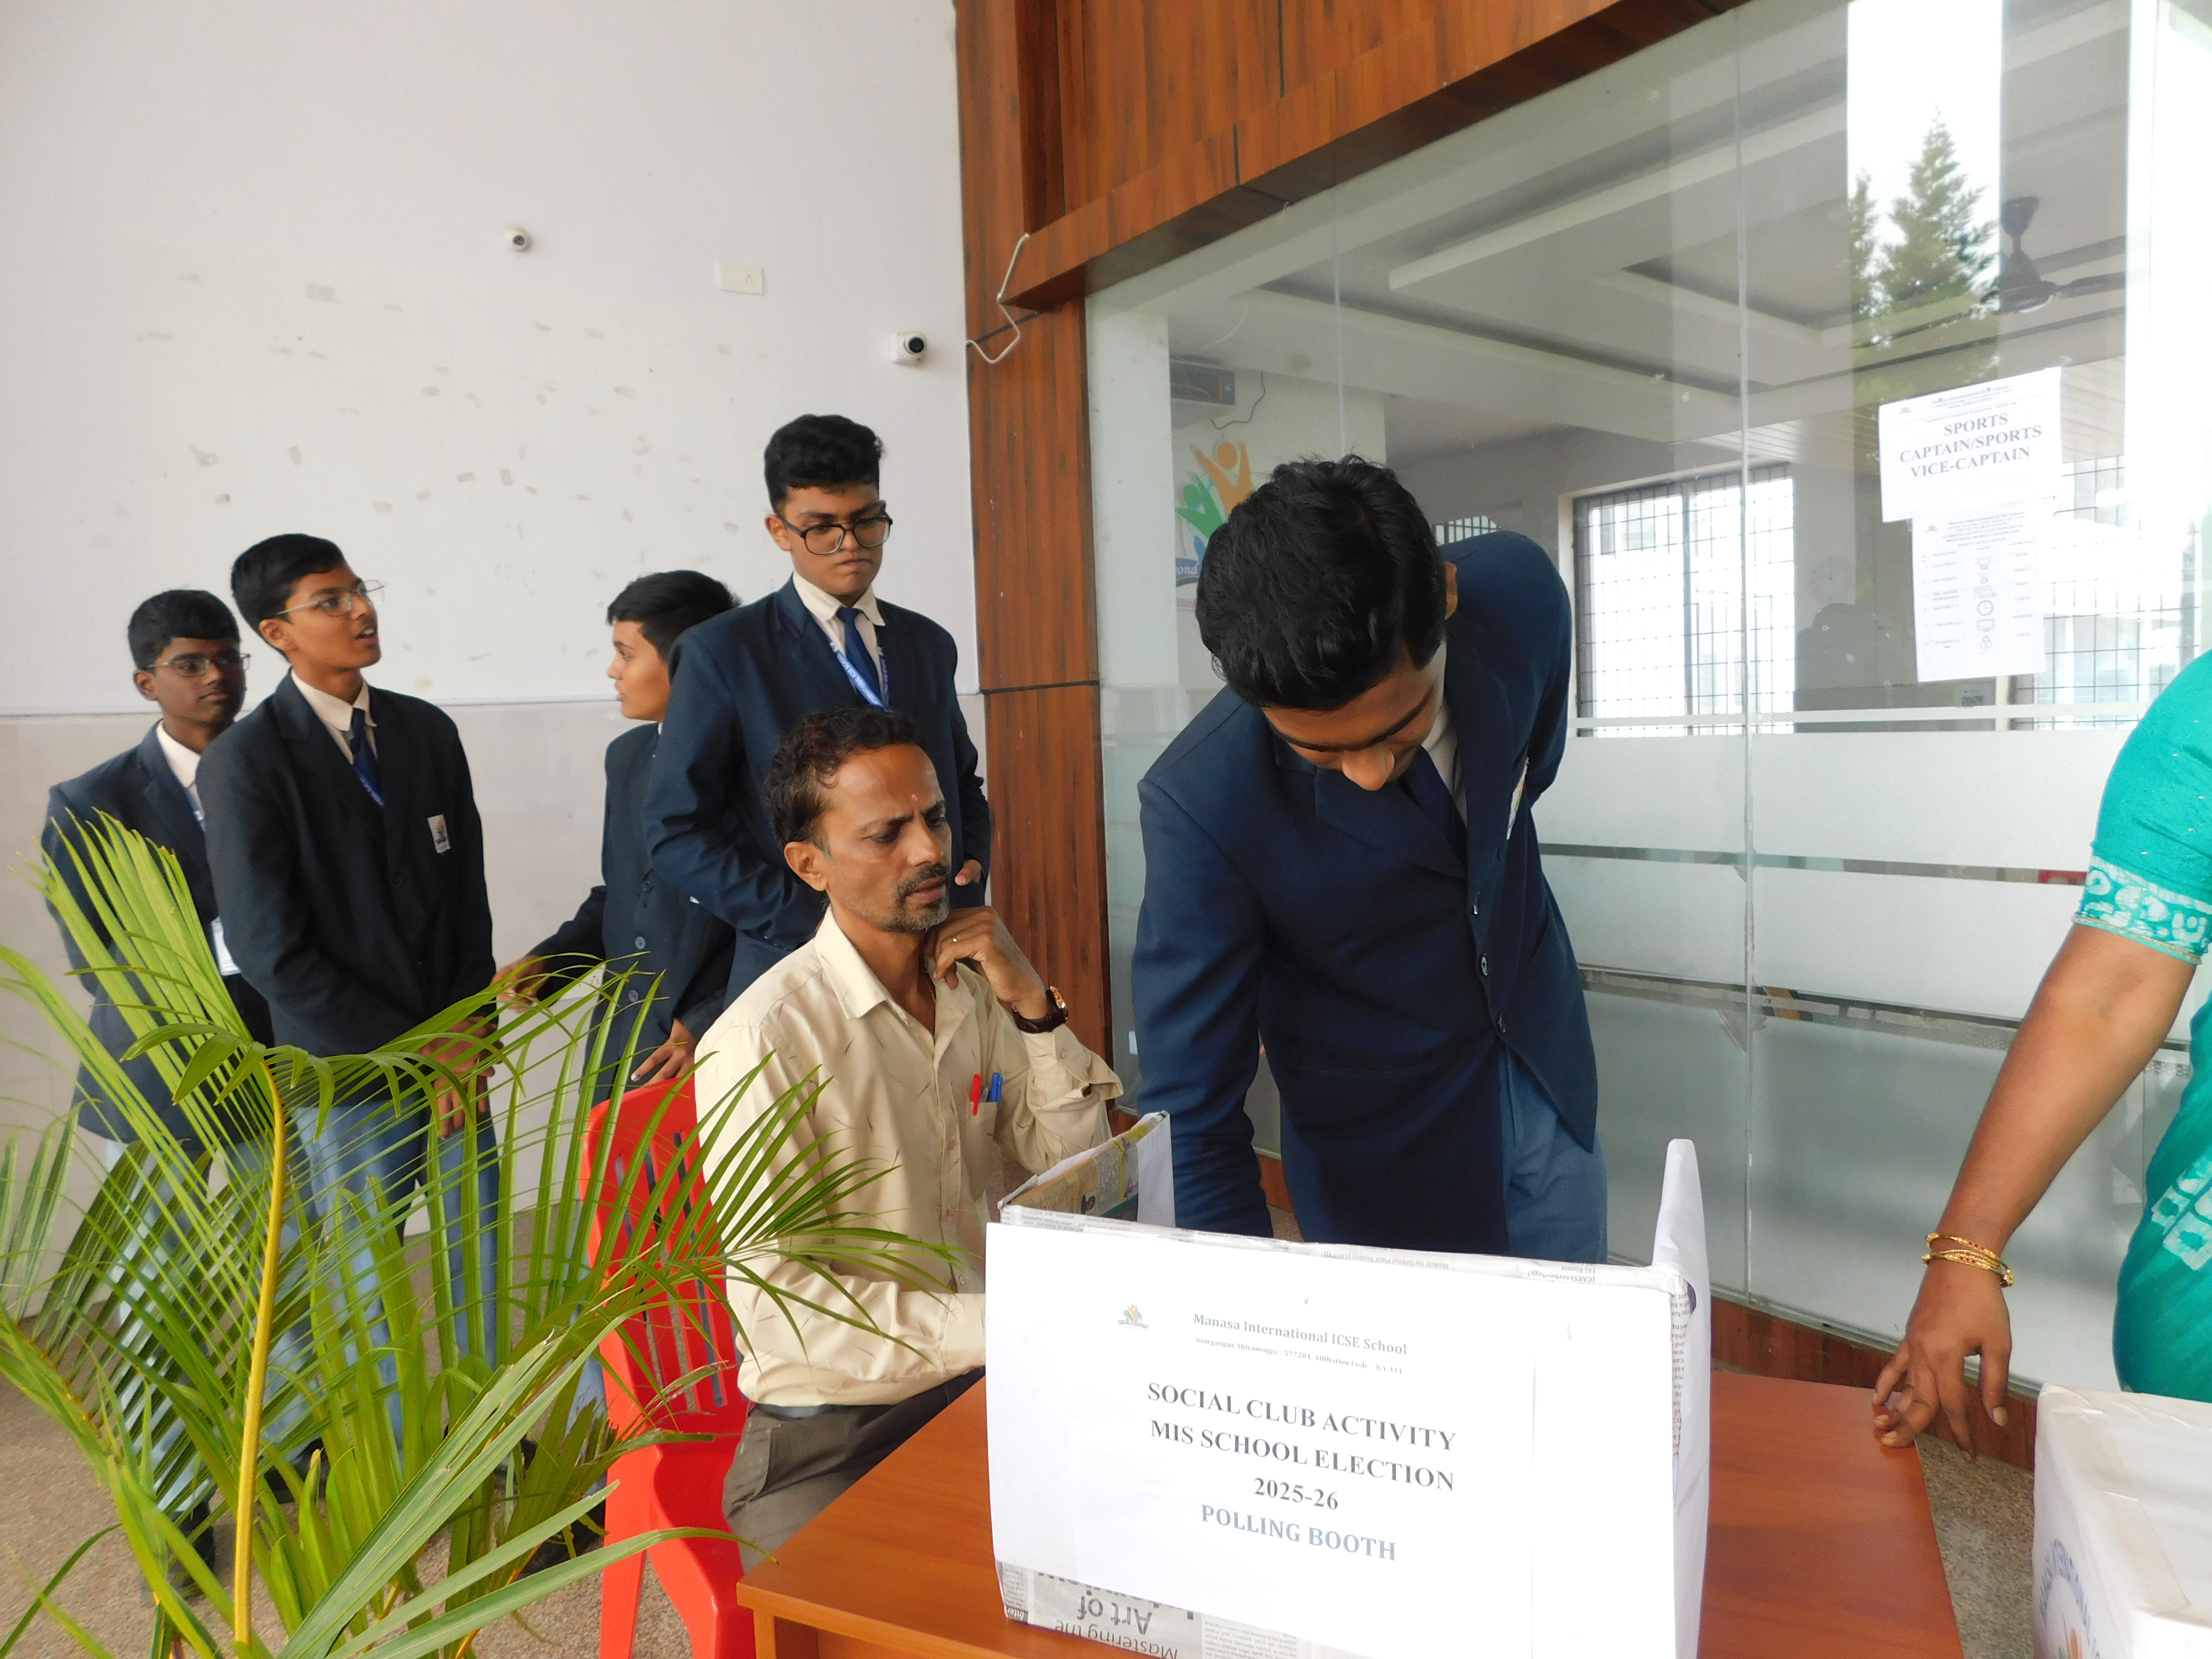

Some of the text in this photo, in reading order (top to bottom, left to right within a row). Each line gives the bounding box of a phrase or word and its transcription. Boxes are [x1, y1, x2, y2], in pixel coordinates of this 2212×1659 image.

[1944, 413, 2008, 436] SPORTS
[1899, 425, 2042, 463] CAPTAIN/SPORTS
[1911, 446, 2031, 478] VICE-CAPTAIN
[1561, 1265, 1583, 1273] Russia
[1194, 1314, 1407, 1355] Manasa International ICSE School
[1237, 1342, 1277, 1355] Shivamogga
[1148, 1382, 1456, 1451] SOCIAL CLUB ACTIVITY
[1150, 1419, 1455, 1492] MIS SCHOOL ELECTION
[1254, 1477, 1339, 1510] 2025-26
[1201, 1504, 1397, 1562] POLLING BOOTH
[1077, 1596, 1103, 1620] of
[1110, 1602, 1152, 1635] Art
[1088, 1623, 1178, 1659] Mastering
